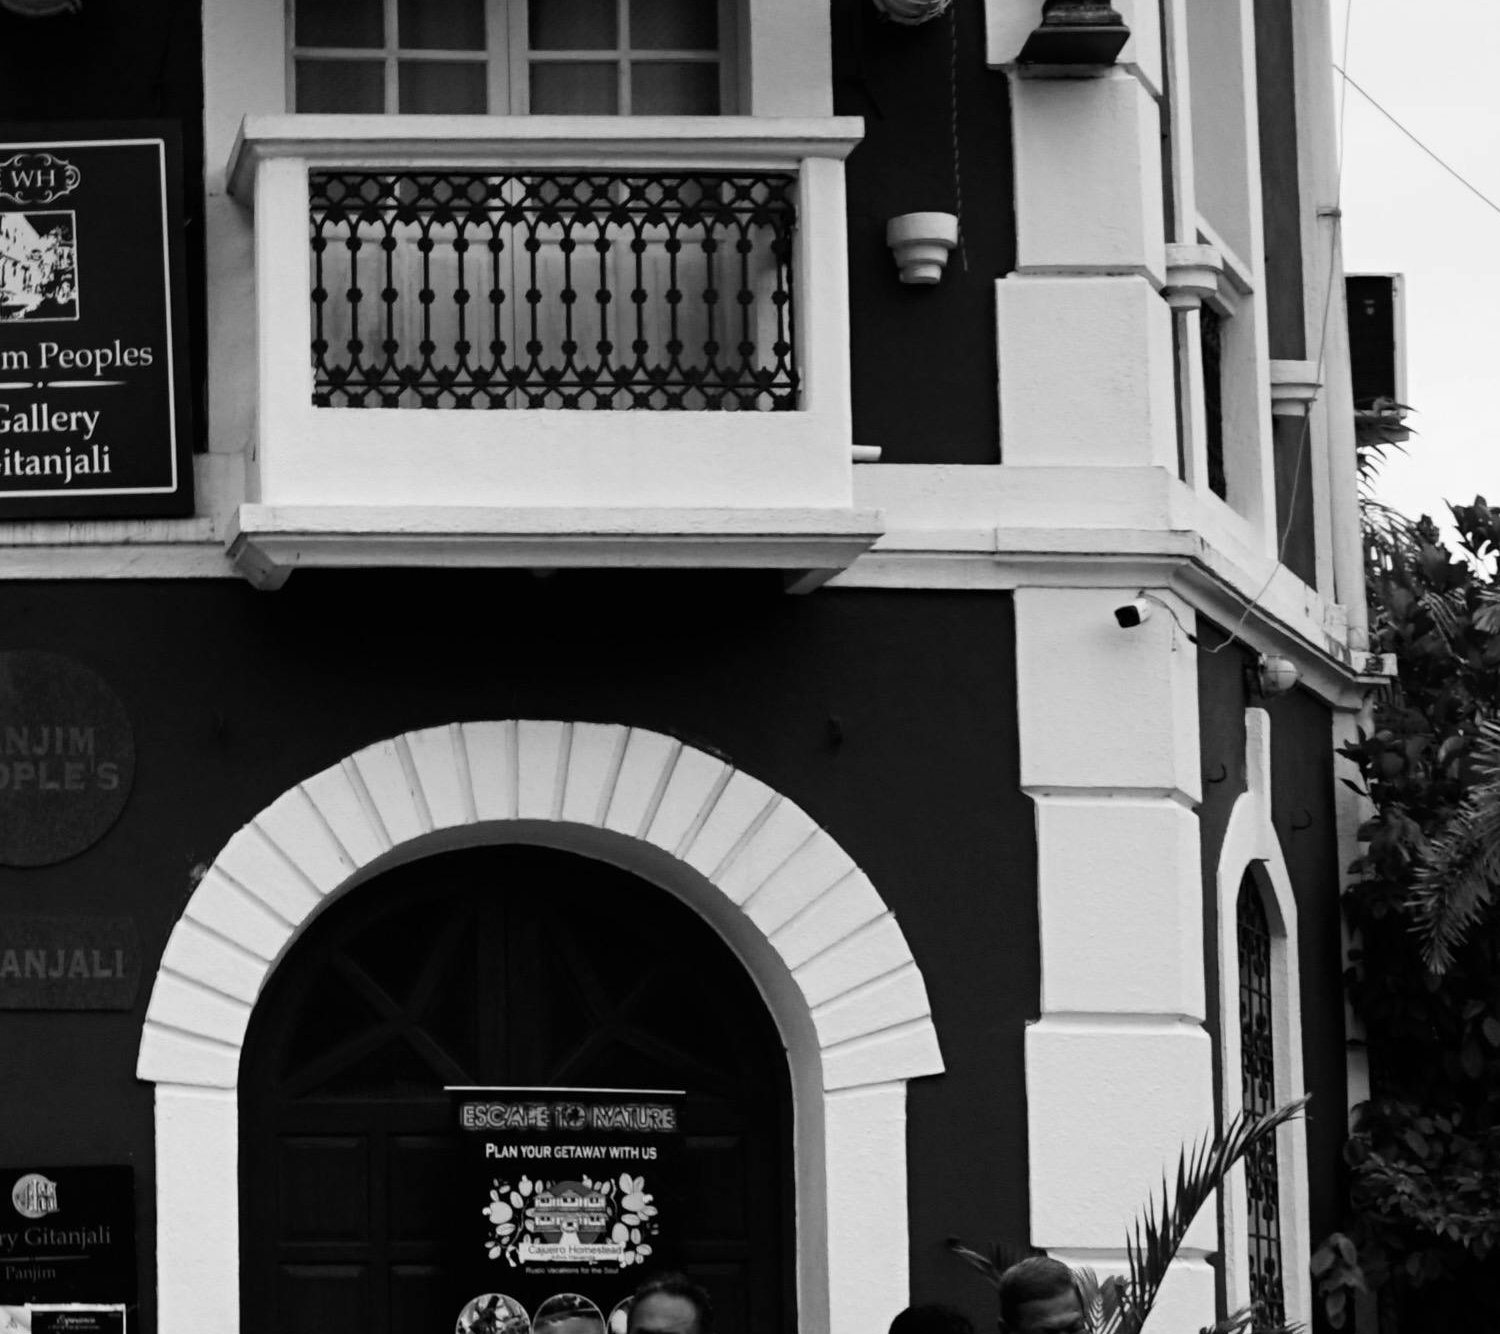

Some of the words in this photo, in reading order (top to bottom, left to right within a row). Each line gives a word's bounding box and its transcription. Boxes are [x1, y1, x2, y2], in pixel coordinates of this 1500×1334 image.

[11, 169, 56, 188] WH
[39, 339, 154, 376] Peoples
[463, 1104, 550, 1128] ESCAPE
[555, 1104, 586, 1130] TO
[592, 1105, 677, 1130] NATURE
[24, 1225, 112, 1250] Gitanjali
[4, 1265, 57, 1283] Panjim
